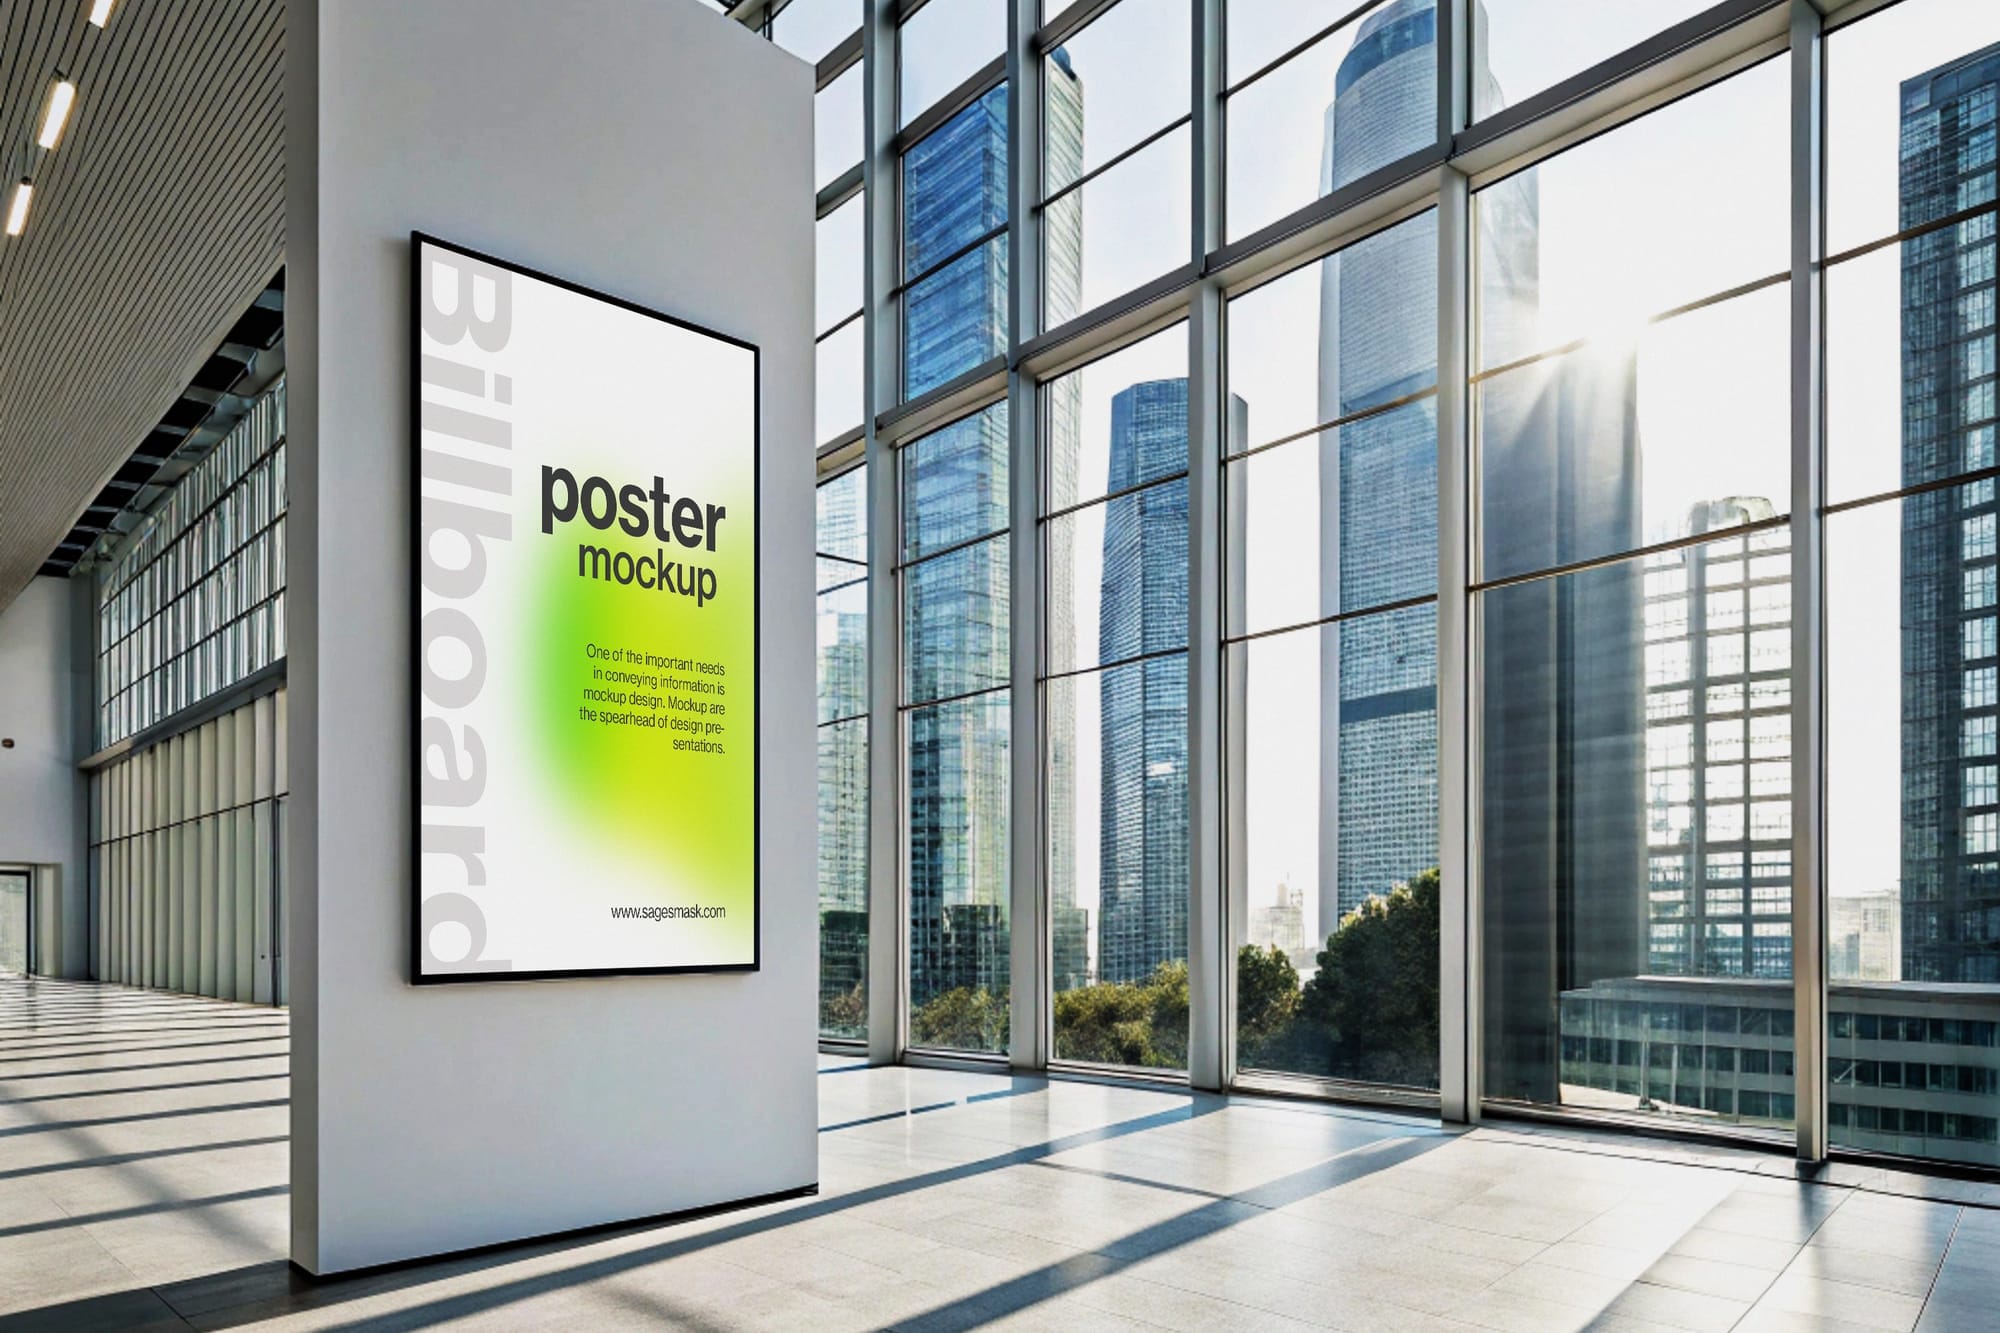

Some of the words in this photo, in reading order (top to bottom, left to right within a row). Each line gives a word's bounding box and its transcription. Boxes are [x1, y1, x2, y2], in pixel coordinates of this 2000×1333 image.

[541, 464, 726, 552] poster
[579, 544, 717, 608] mockup
[421, 242, 512, 973] Billboard
[586, 643, 610, 660] One
[612, 648, 623, 662] of
[626, 650, 642, 665] the
[645, 652, 693, 671] important
[696, 662, 725, 676] needs
[593, 665, 602, 680] in
[605, 670, 658, 690] conveying
[660, 674, 715, 695] information
[717, 681, 725, 695] is
[583, 688, 626, 706] mockup
[629, 691, 666, 709] design.
[668, 695, 707, 715] Mockup
[709, 704, 725, 715] are
[579, 706, 597, 721] the
[599, 711, 655, 727] spearhead
[658, 715, 668, 729] of
[670, 716, 703, 734] design
[705, 722, 725, 735] pre-
[673, 738, 726, 754] sentations.
[611, 904, 726, 922] www.sagesmask.com
